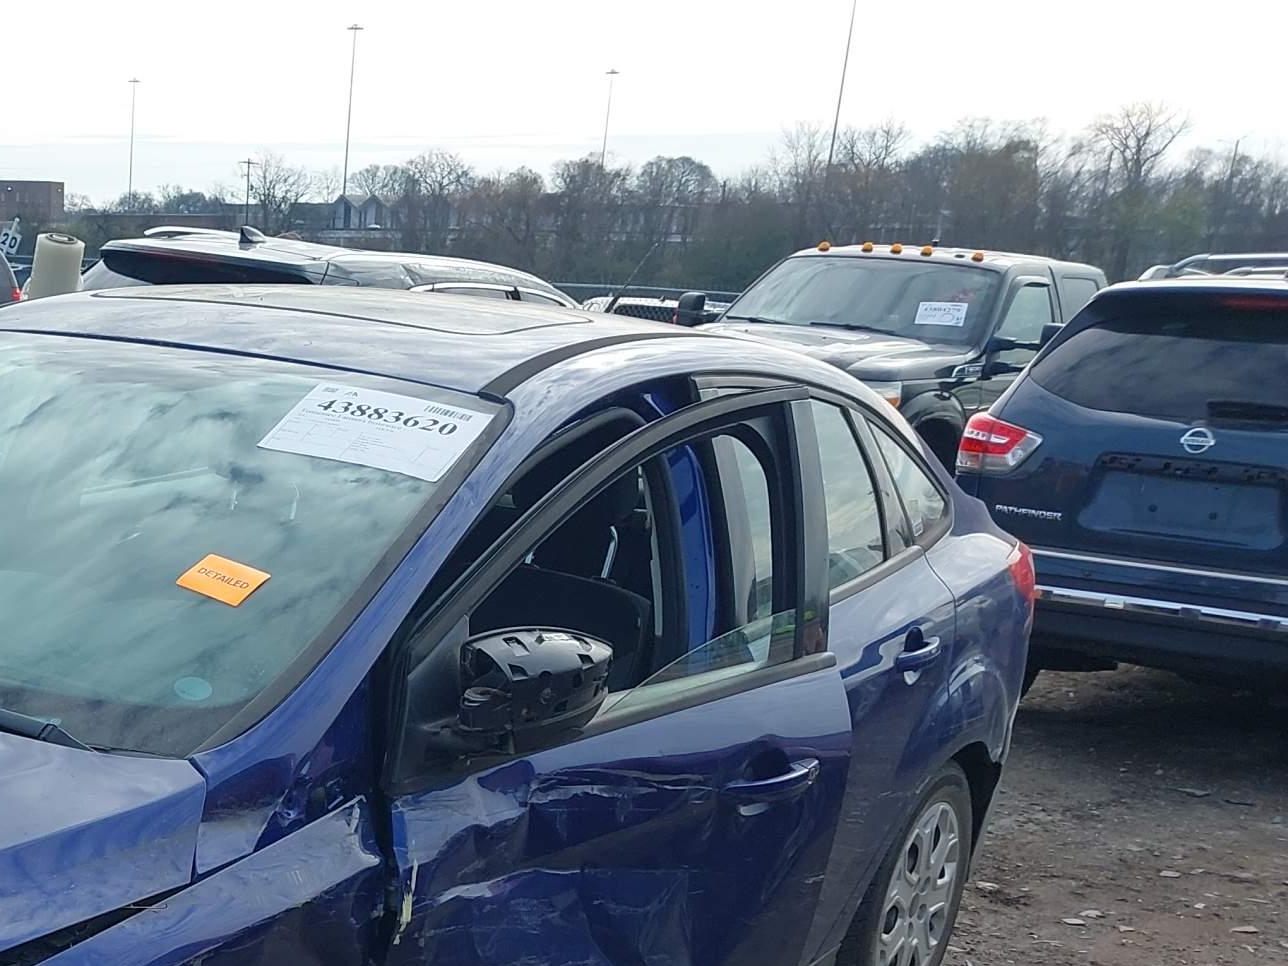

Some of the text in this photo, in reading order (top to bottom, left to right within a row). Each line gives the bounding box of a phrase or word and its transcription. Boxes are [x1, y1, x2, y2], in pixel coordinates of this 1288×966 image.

[0, 233, 18, 249] 20
[316, 399, 458, 436] 43883620
[995, 504, 1062, 520] PATHFINDER
[197, 567, 250, 589] DETAILED
